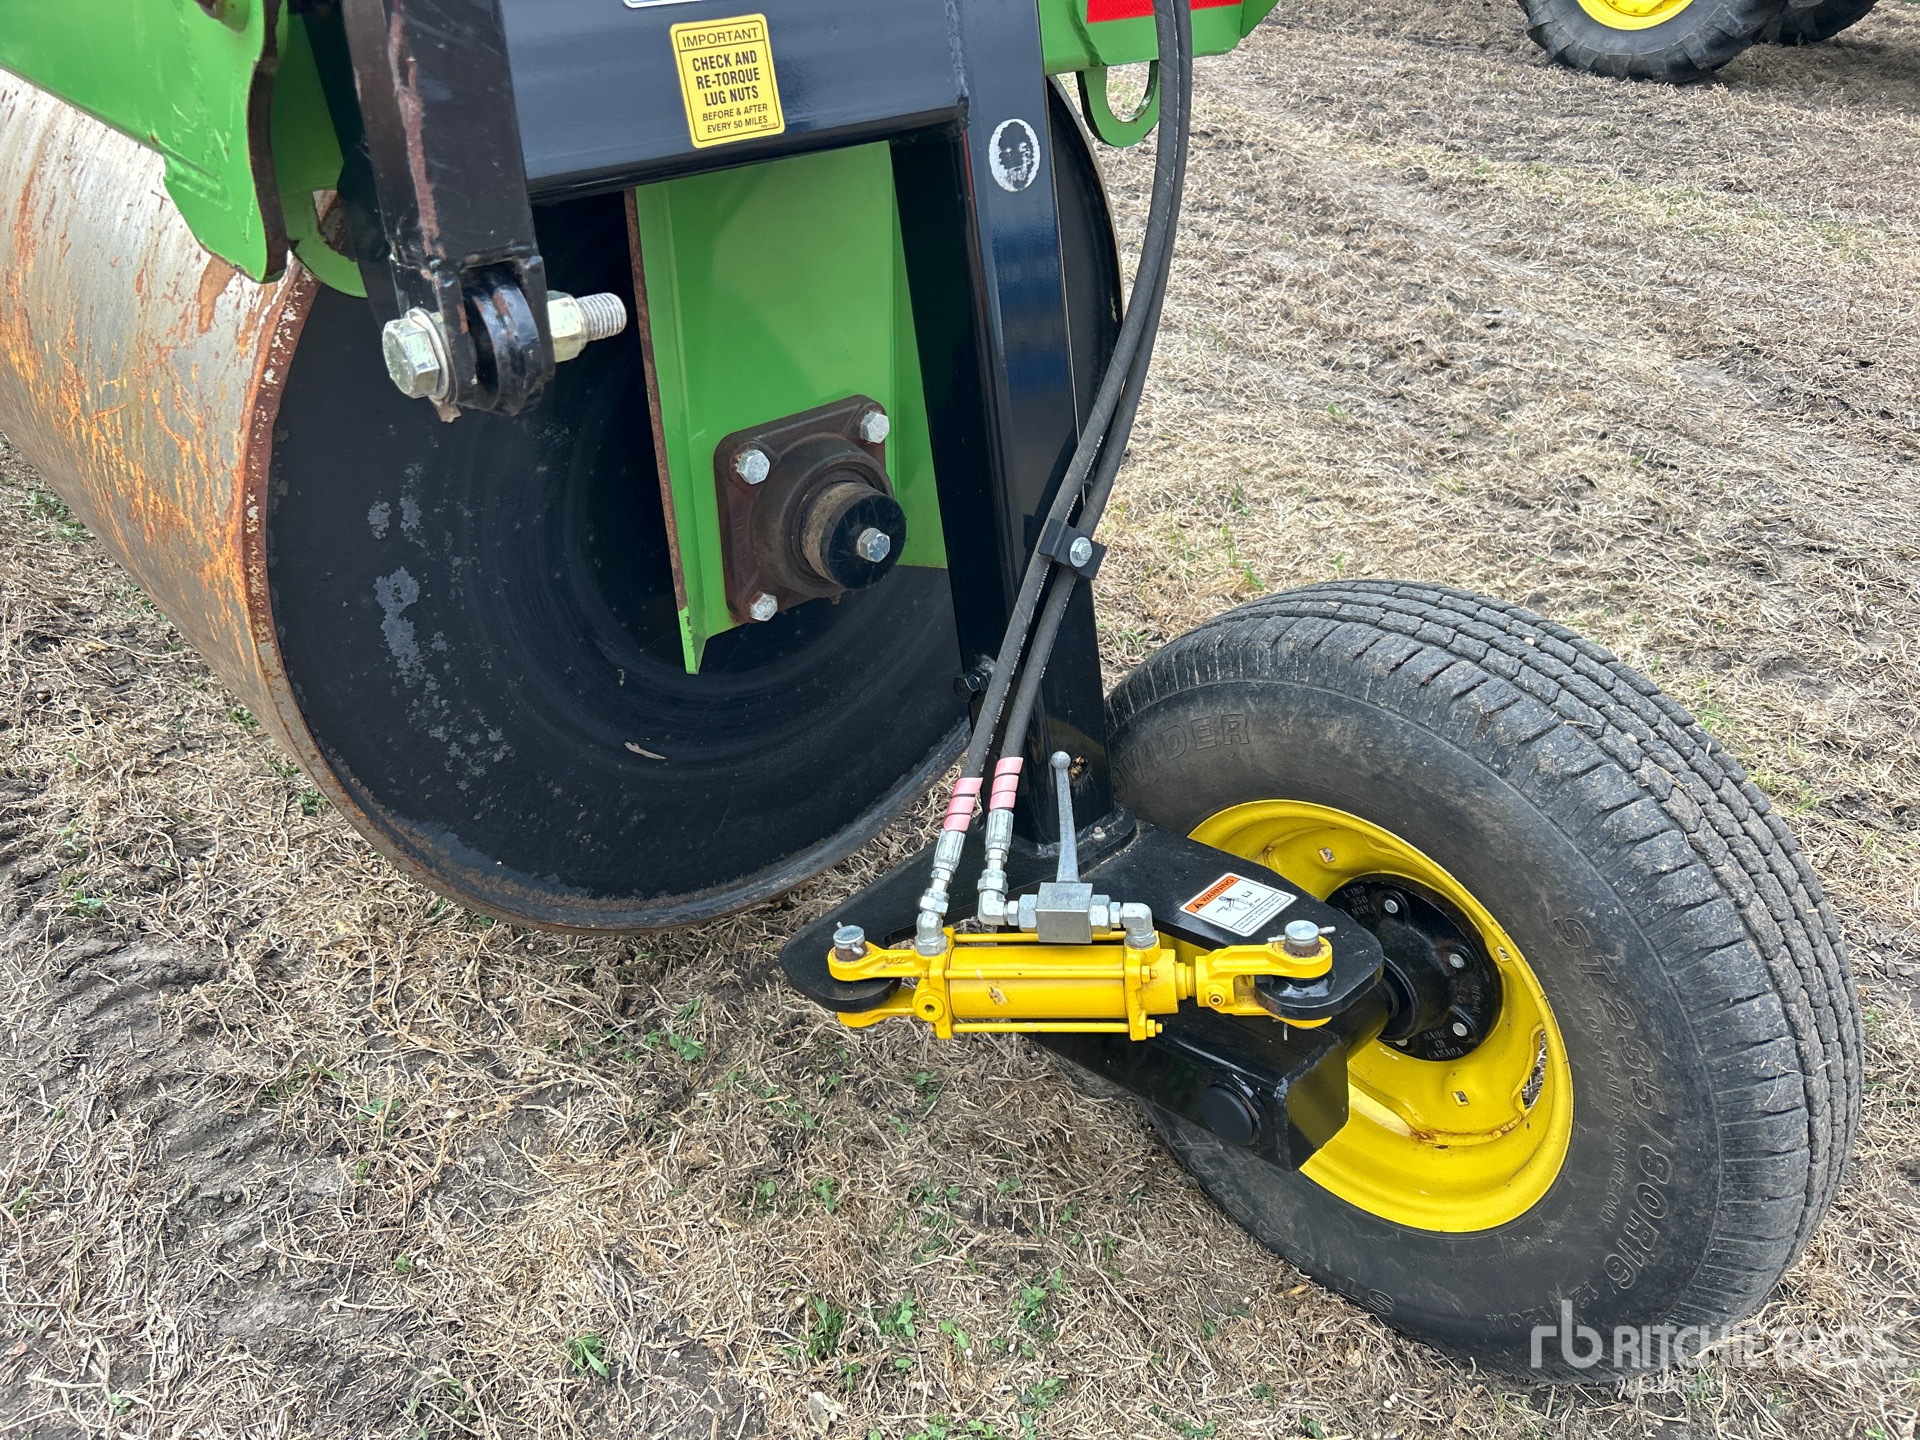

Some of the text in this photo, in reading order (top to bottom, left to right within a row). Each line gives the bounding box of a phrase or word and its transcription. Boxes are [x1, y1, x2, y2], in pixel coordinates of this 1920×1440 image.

[682, 27, 759, 48] IMPORTANT
[692, 49, 758, 72] CHECK AND
[696, 67, 761, 90] RE-TORQUE
[704, 85, 759, 107] LUG NUTS
[702, 103, 768, 122] BEFORE & AFTER
[707, 121, 731, 134] EVERY
[733, 120, 743, 129] 50
[745, 115, 768, 127] MILES
[1200, 878, 1234, 902] WARNING
